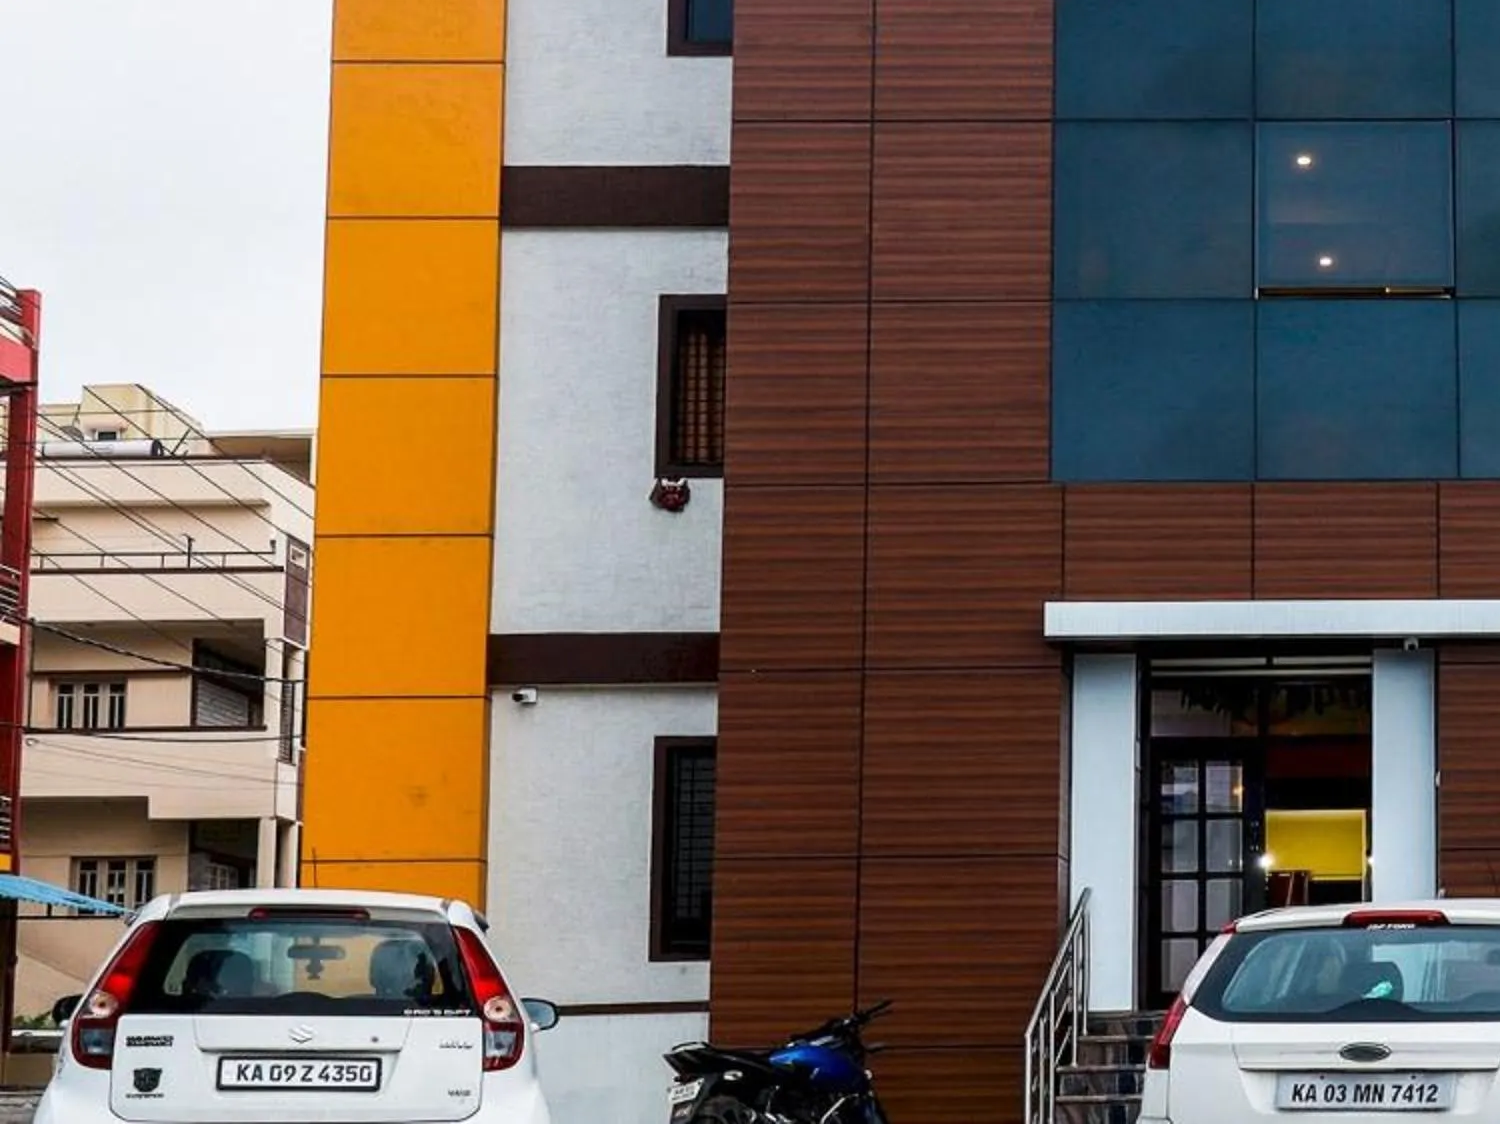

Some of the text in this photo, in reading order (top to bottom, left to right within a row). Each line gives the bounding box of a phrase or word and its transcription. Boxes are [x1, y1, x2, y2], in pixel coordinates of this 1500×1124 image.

[236, 1064, 372, 1082] KA 09 Z 4350
[1291, 1083, 1439, 1103] KA 03 MN 7412
